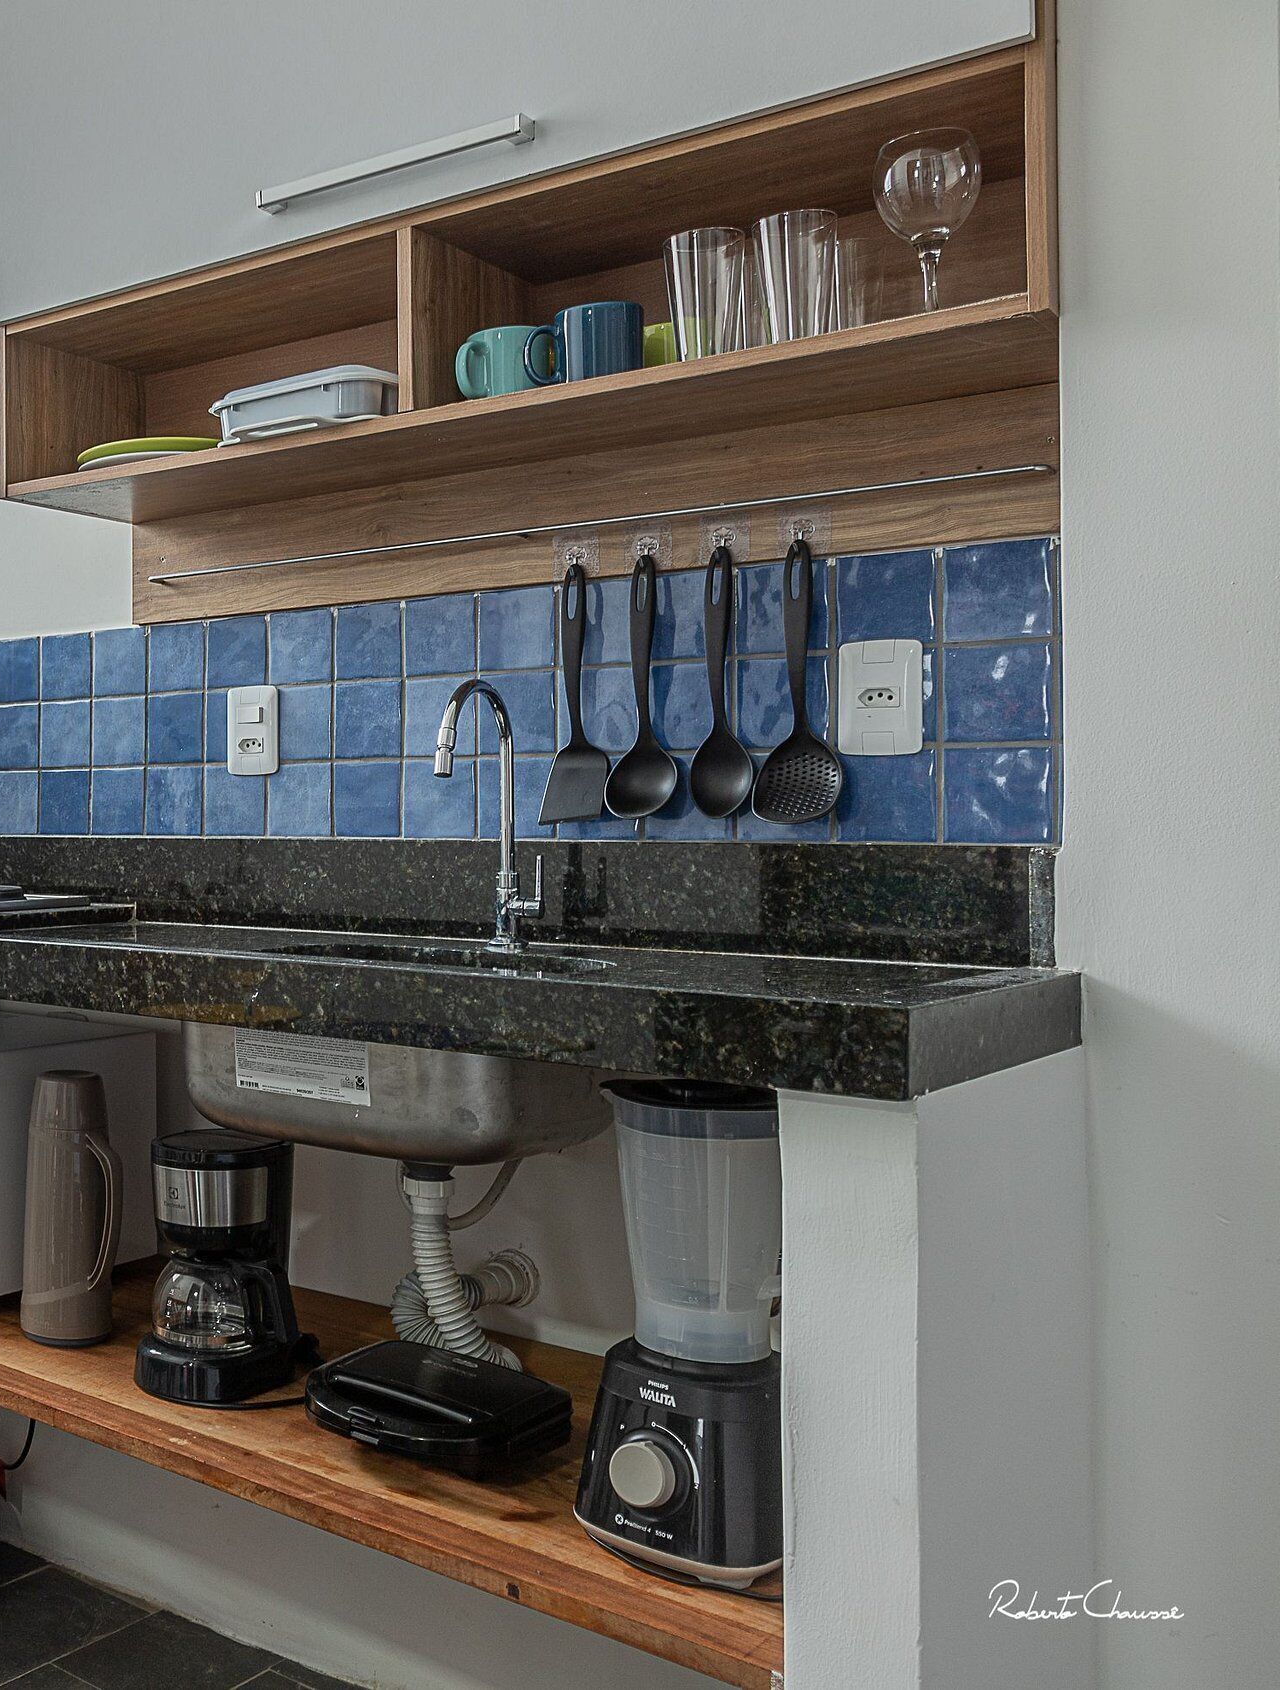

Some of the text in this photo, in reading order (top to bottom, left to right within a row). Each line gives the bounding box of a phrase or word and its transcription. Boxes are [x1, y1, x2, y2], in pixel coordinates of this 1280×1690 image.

[647, 1379, 669, 1391] PHILIPS
[639, 1386, 677, 1408] WALITA
[655, 1530, 666, 1538] 550
